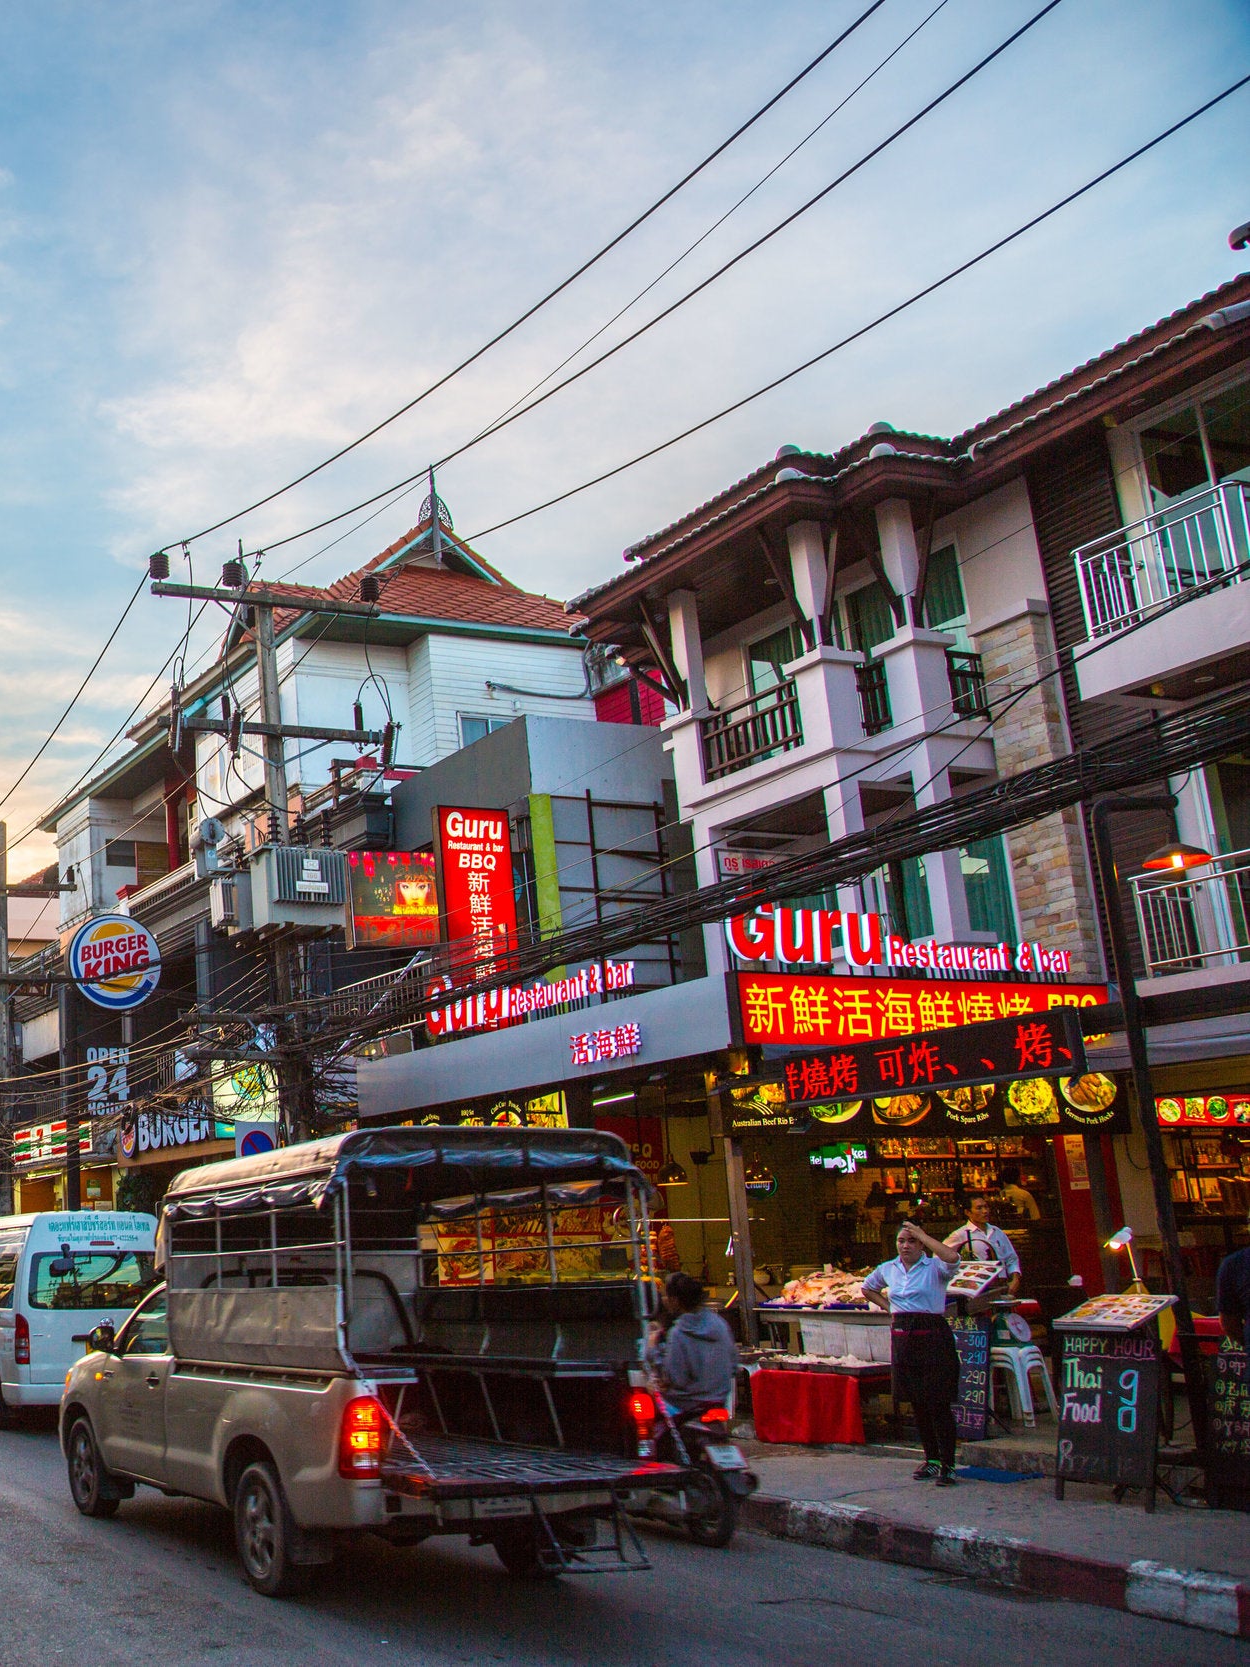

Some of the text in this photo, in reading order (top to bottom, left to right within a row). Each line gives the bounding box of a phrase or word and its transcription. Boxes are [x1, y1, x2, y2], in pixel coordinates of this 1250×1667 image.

[446, 811, 502, 841] Guru
[448, 840, 504, 853] Restaurant & bar
[459, 853, 496, 871] BBQ
[725, 888, 883, 967] Guru
[81, 934, 149, 962] BURGER
[885, 934, 1072, 973] Restaurant & bar
[83, 949, 150, 986] KING
[425, 959, 635, 1036] Guru Restaurant & bar
[746, 983, 1033, 1038] 新鮮活海鮮燒烤
[86, 1046, 130, 1064] OPEN
[569, 1022, 642, 1065] 活海鮮
[87, 1065, 130, 1102] 24
[732, 1118, 762, 1128] Australian
[762, 1116, 777, 1127] Beef
[777, 1116, 789, 1126] Rib
[946, 1110, 990, 1125] Pork Spare Ribs
[1064, 1107, 1085, 1124] German
[1085, 1114, 1099, 1125] Pork
[1063, 1336, 1155, 1357] HAPPY HOUR
[1062, 1357, 1103, 1389] Thai
[1061, 1391, 1102, 1423] Food
